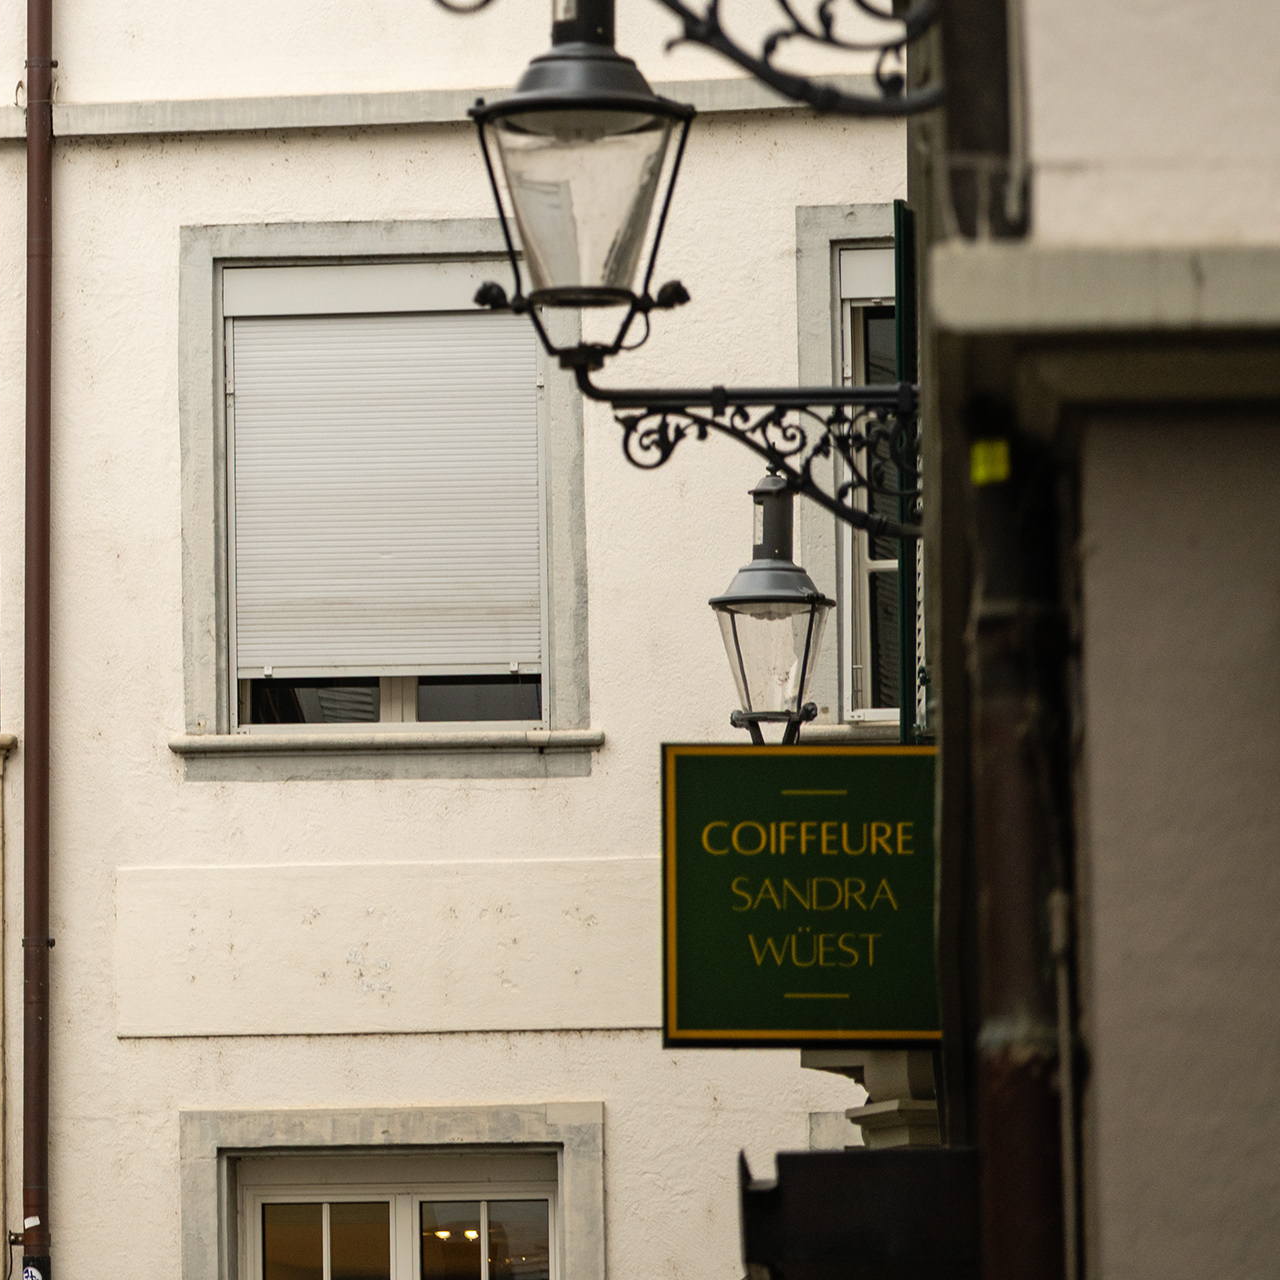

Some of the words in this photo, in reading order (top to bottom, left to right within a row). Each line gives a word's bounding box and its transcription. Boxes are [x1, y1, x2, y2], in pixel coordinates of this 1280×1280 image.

[701, 821, 915, 856] COIFFEURE
[731, 876, 898, 912] SANDRA
[748, 926, 883, 967] WÜEST
